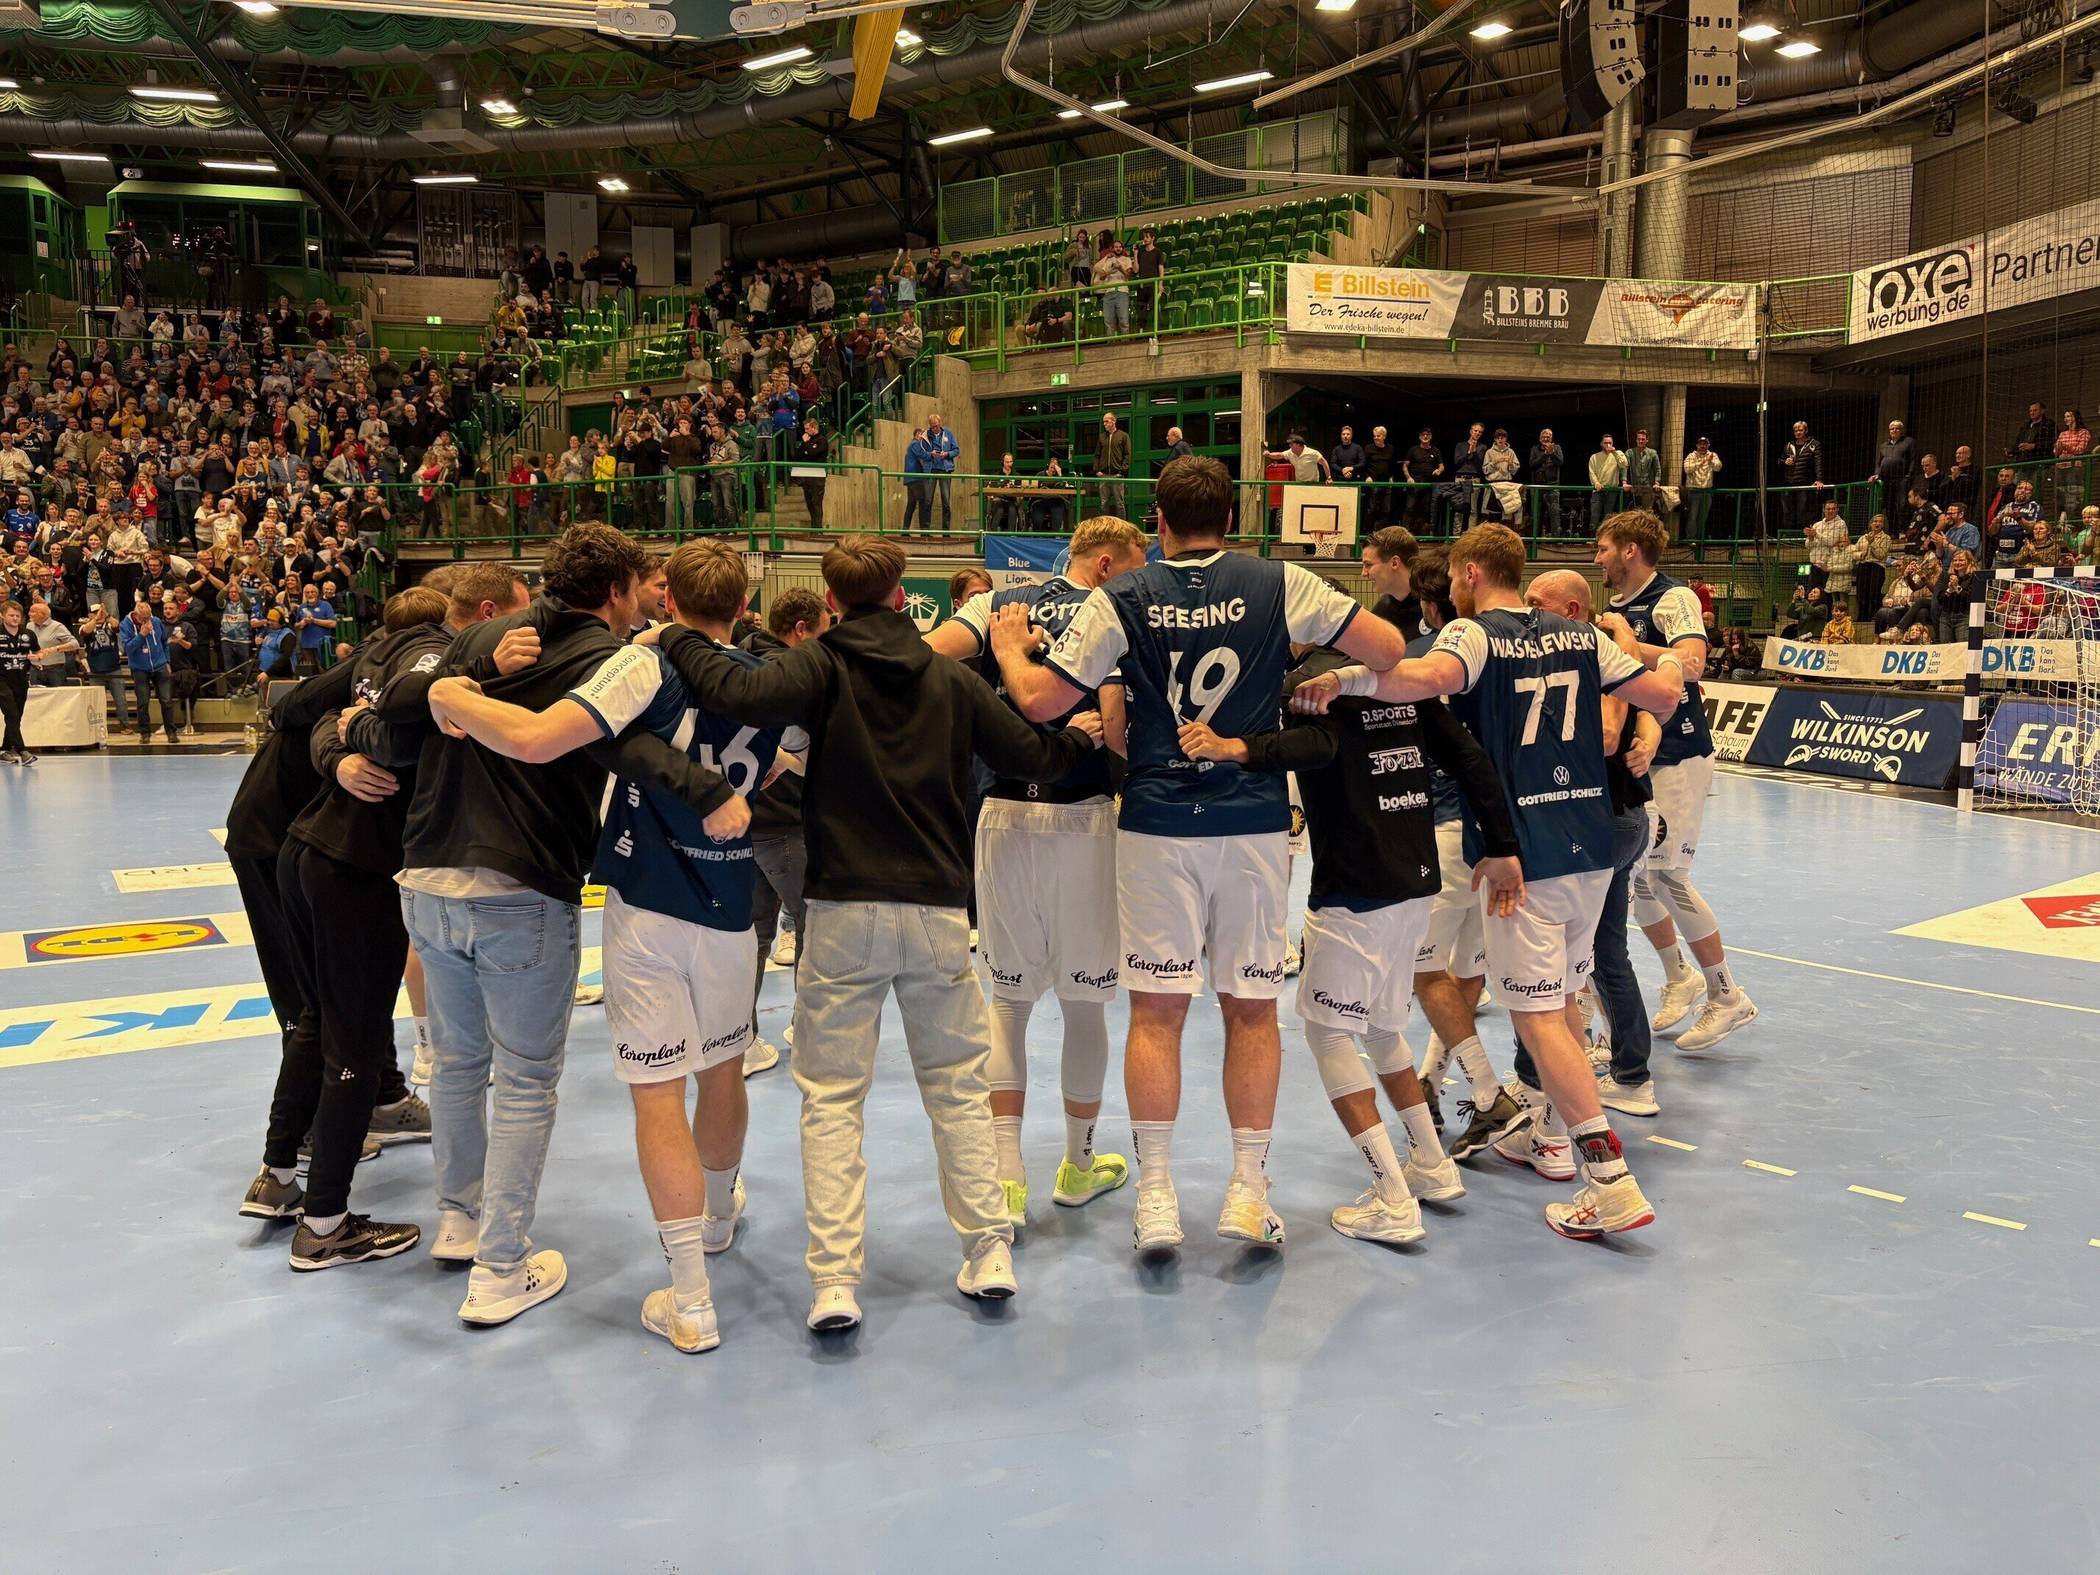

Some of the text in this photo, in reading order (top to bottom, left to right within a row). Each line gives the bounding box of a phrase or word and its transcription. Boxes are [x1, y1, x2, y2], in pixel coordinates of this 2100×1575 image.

[1342, 274, 1431, 298] Billstein
[1620, 293, 1666, 304] Billstein
[1309, 303, 1429, 324] Der Frische wegen!
[1867, 292, 1970, 332] werbung.de
[1323, 322, 1405, 334] www.edeka-billstein.de
[1497, 317, 1569, 329] BILLSTEINS BREMME BRÄU
[1007, 557, 1031, 568] Blue
[1147, 597, 1246, 630] SEESING
[1778, 645, 1826, 671] DKB
[1982, 645, 2036, 673] DKB
[2041, 646, 2054, 655] Das
[1824, 664, 1838, 672] Bank
[1827, 657, 1840, 665] kann
[1881, 650, 1929, 674] DKB
[1926, 666, 1939, 674] Bank
[1929, 658, 1941, 666] kann
[1514, 670, 1580, 747] 77
[1843, 714, 1866, 722] SINCE
[1712, 731, 1750, 748] Schaum
[1790, 718, 1930, 753] WILKINSON
[1819, 746, 1872, 764] SWORD
[1998, 765, 2056, 787] WÄNDE
[1027, 783, 1038, 798] 8
[1517, 789, 1570, 807] GOTTFRIED
[1126, 953, 1195, 975] Coroplast
[1071, 967, 1119, 989] Coropla
[1501, 977, 1563, 996] Coroplast
[617, 1038, 686, 1066] Coroplast
[1456, 1055, 1469, 1074] CRAFT
[1361, 1144, 1379, 1169] CRAFT
